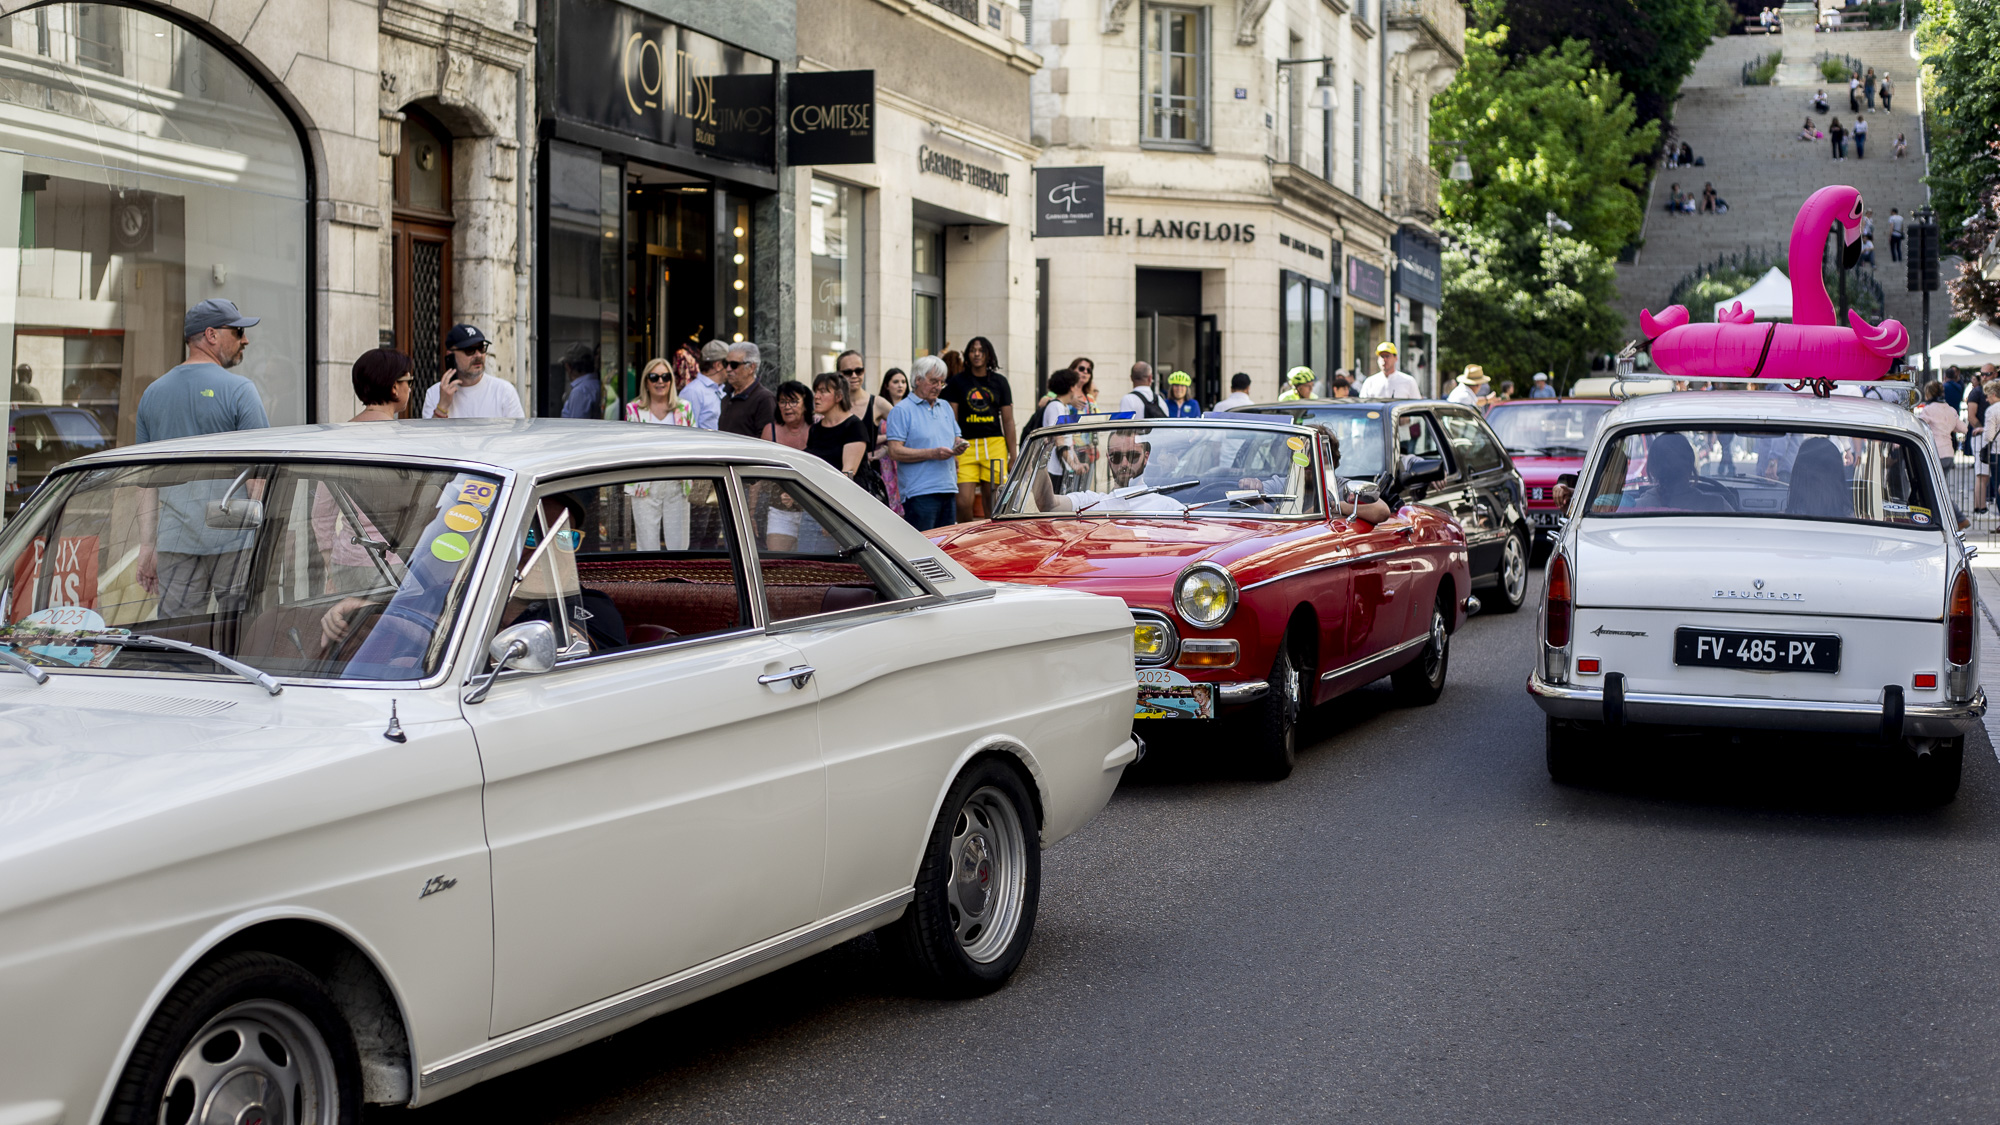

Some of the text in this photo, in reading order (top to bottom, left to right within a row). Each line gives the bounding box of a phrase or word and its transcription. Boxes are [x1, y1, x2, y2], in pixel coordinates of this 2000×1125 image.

[624, 31, 717, 126] COMTESSE
[790, 104, 871, 134] COMTESSE
[1136, 218, 1256, 243] LANGLOIS
[966, 414, 995, 423] ellesse
[463, 484, 492, 498] 20
[448, 510, 479, 525] SAMEDI
[435, 539, 465, 554] DIMANCHE
[1714, 589, 1803, 601] PEUGEOT
[38, 609, 87, 625] 2023
[1697, 636, 1815, 665] FV-485-PX
[1137, 671, 1171, 683] 2023
